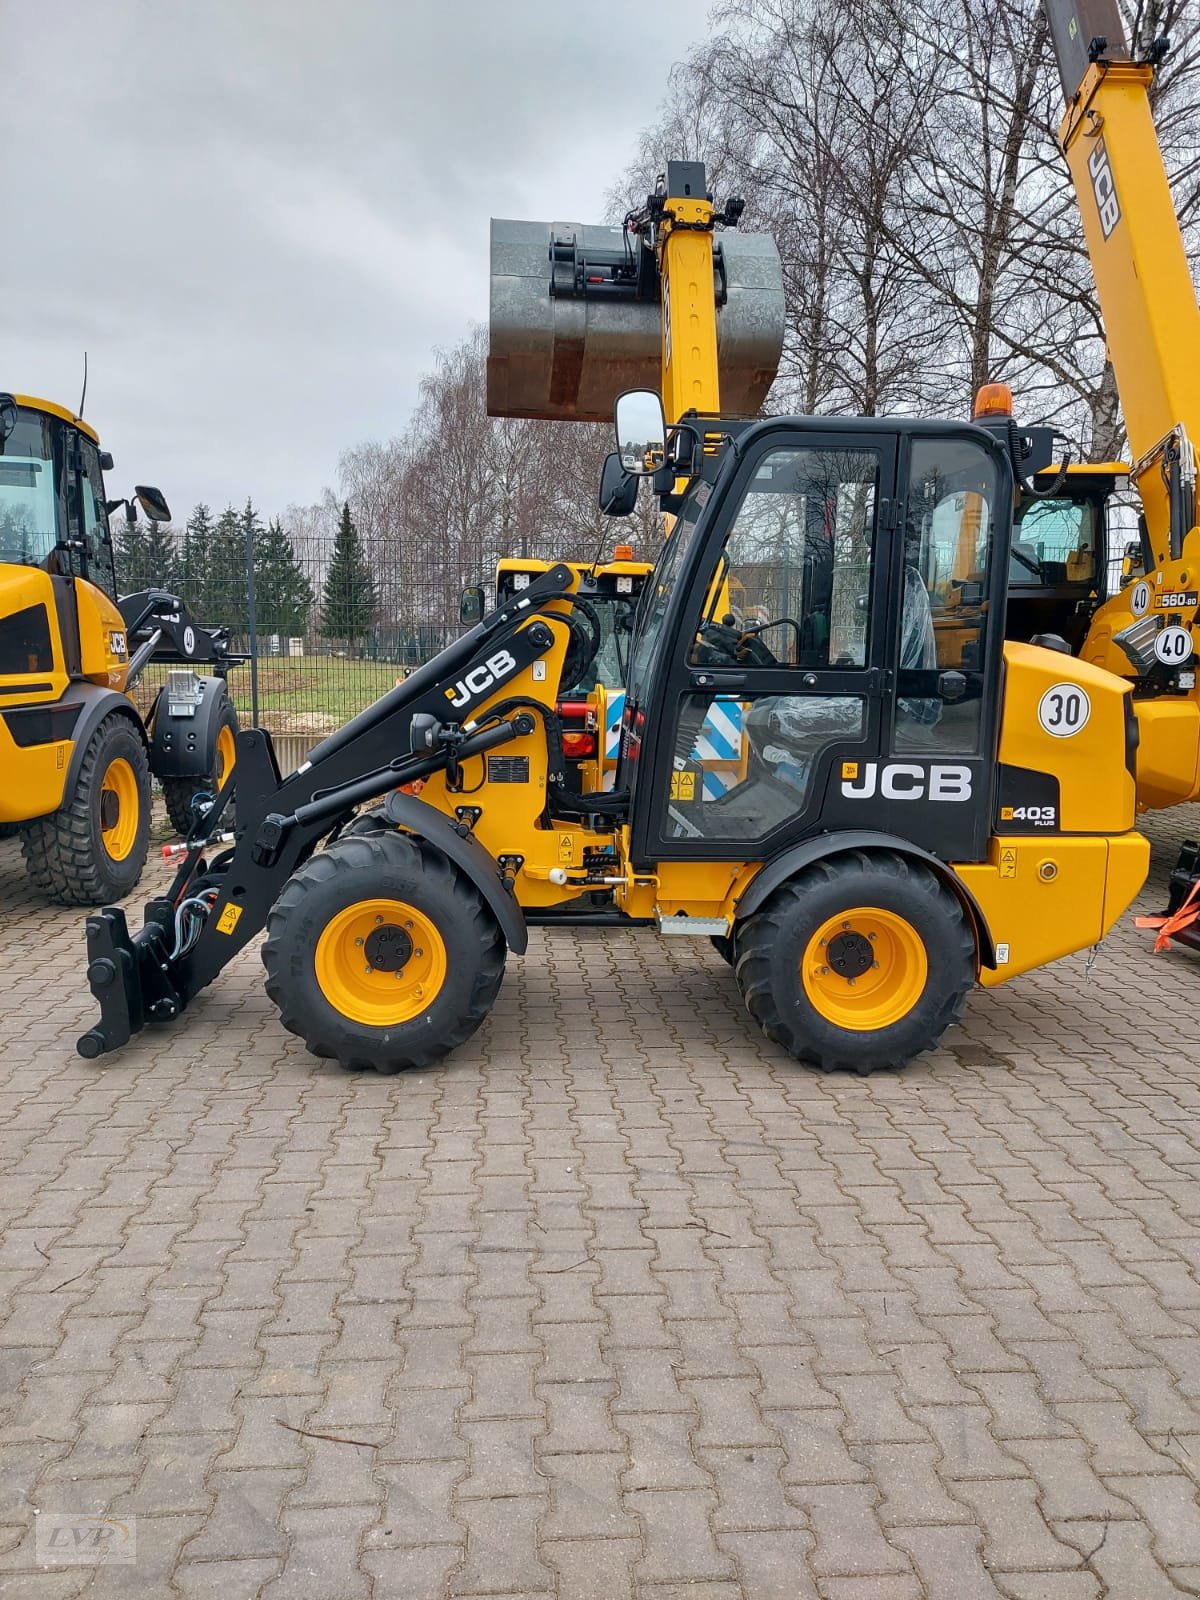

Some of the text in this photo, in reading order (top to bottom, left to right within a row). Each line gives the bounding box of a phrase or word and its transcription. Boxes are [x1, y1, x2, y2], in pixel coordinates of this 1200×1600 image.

[1089, 151, 1119, 236] JCB
[1134, 588, 1147, 610] 40
[109, 632, 126, 653] JCB
[1162, 634, 1185, 657] 40
[451, 650, 517, 708] JCB
[1048, 694, 1081, 726] 30
[841, 762, 972, 802] JCB
[1013, 806, 1056, 820] 403
